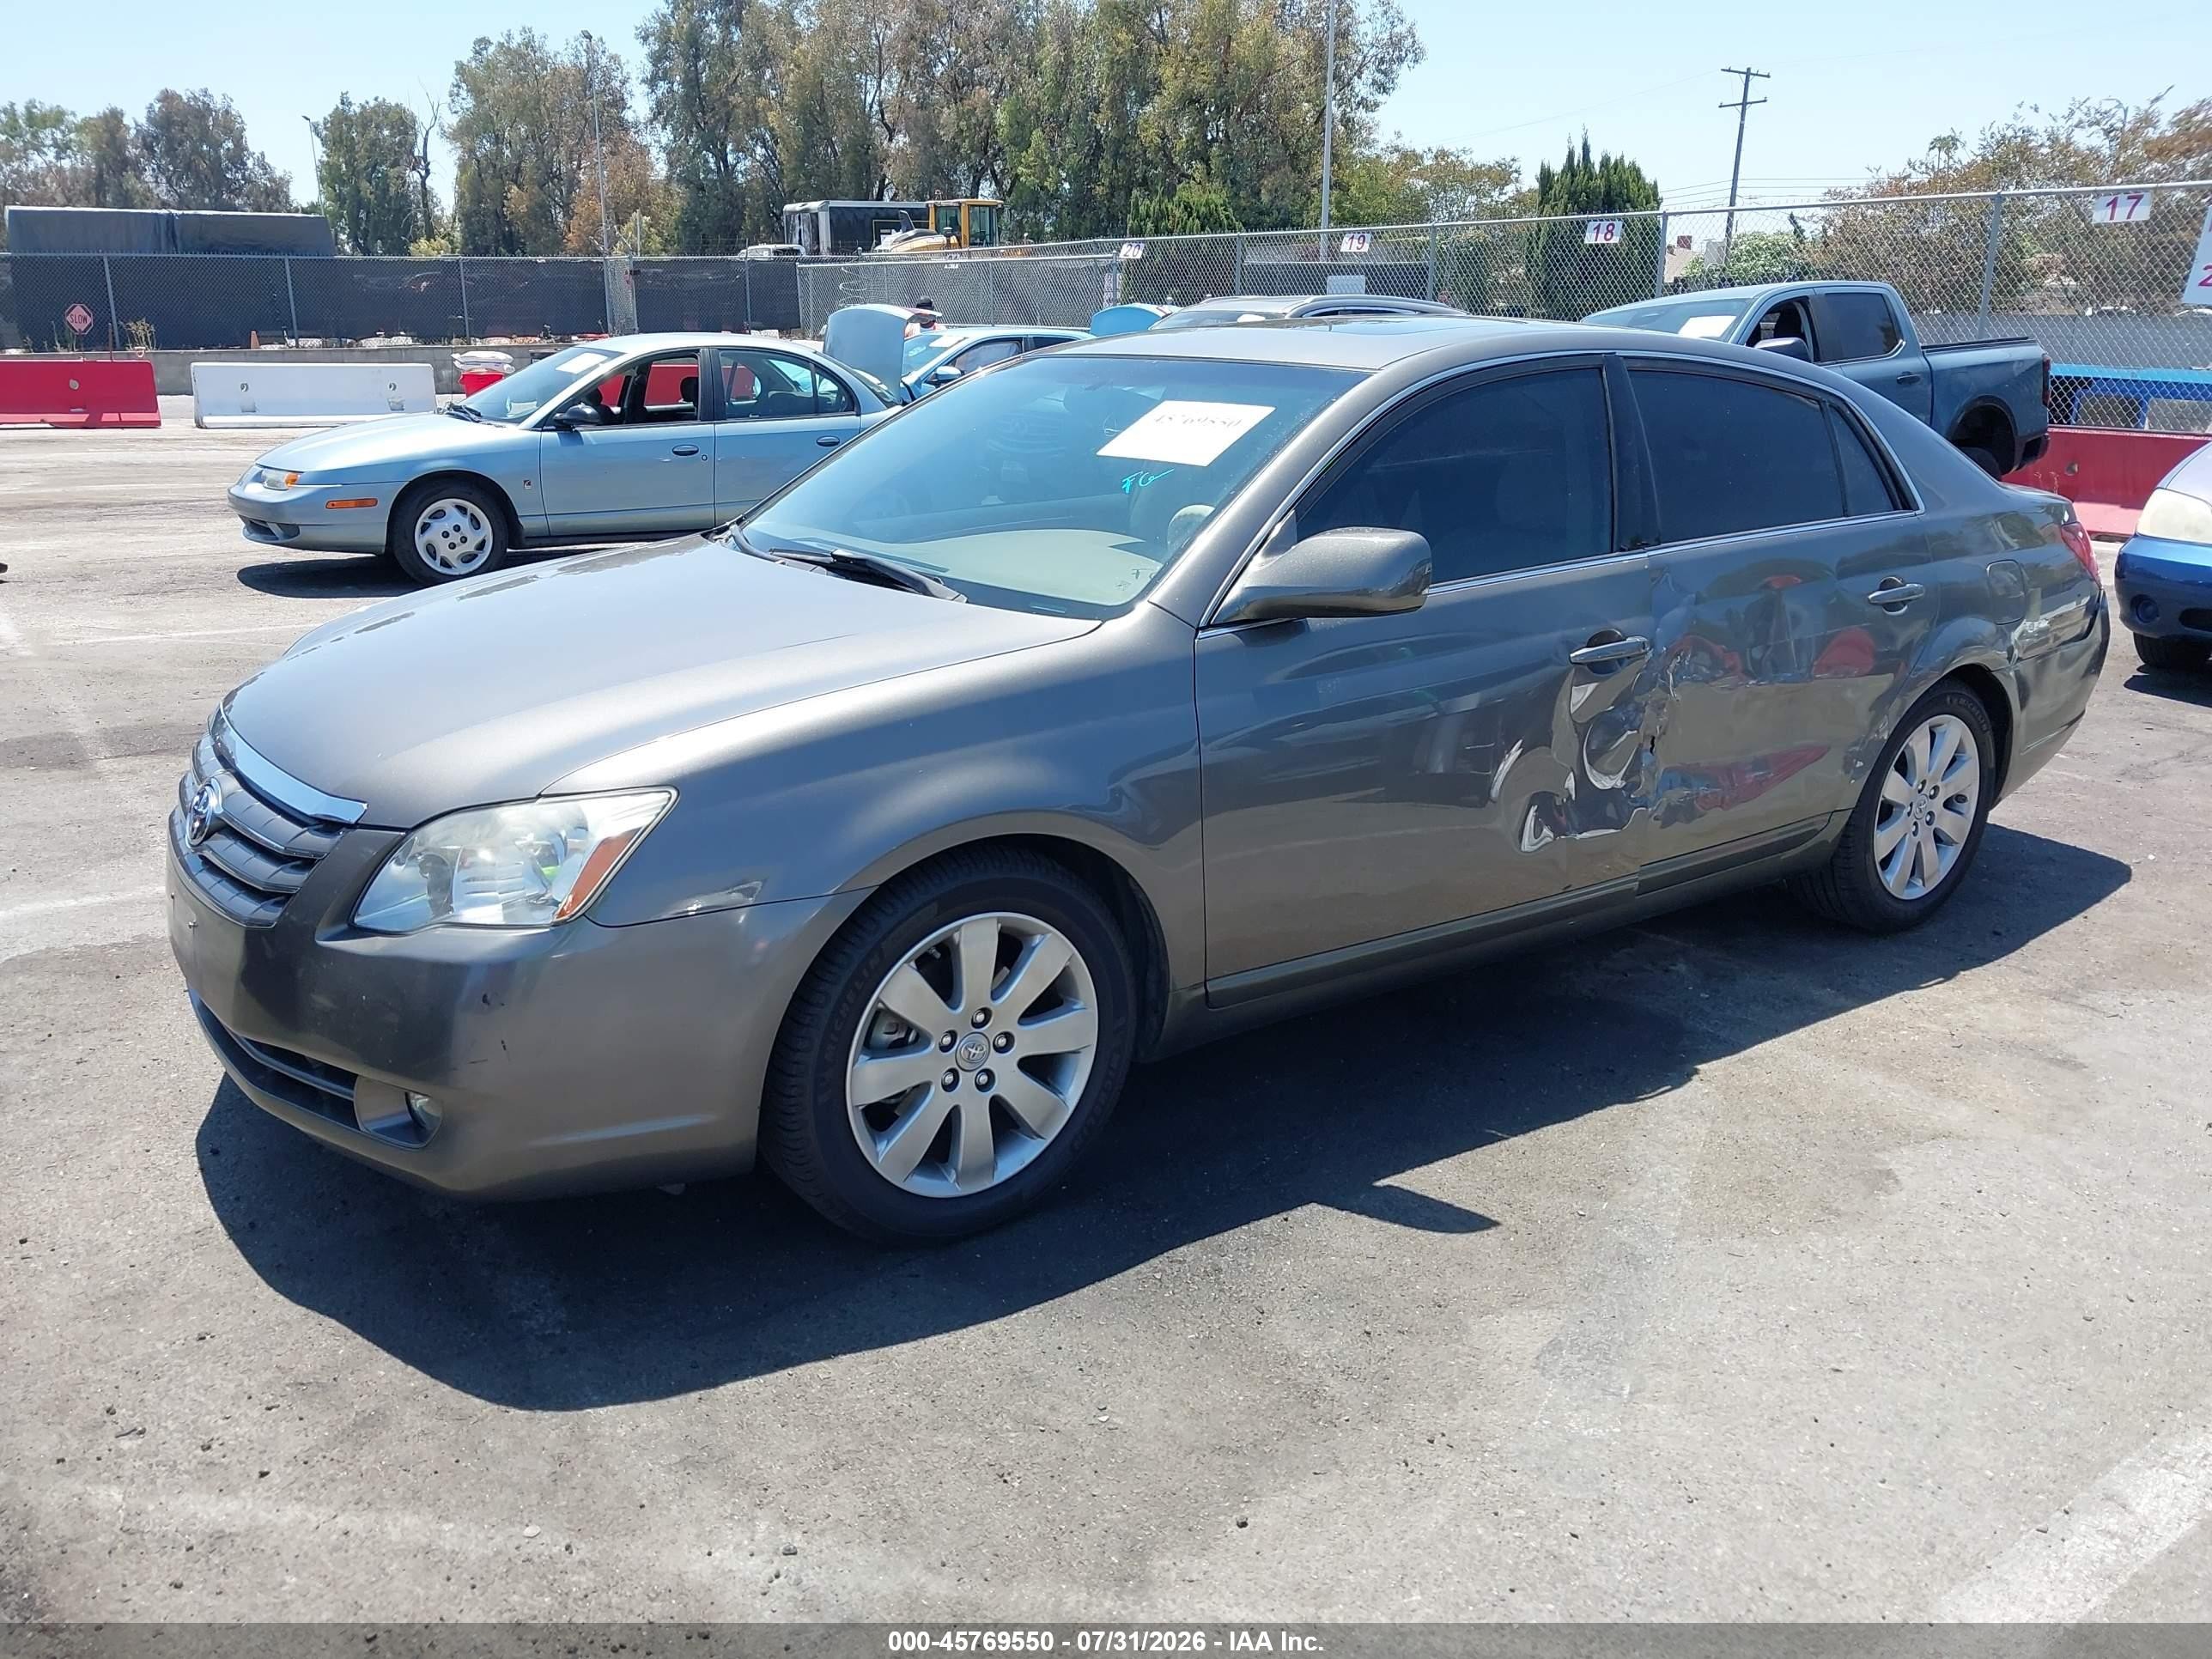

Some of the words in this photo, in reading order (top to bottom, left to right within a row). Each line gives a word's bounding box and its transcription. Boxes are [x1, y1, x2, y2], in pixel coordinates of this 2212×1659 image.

[2106, 194, 2144, 221] 17
[1593, 222, 1615, 241] 18
[1123, 244, 1141, 258] 20
[1348, 234, 1366, 251] 19
[70, 313, 88, 324] SLOW
